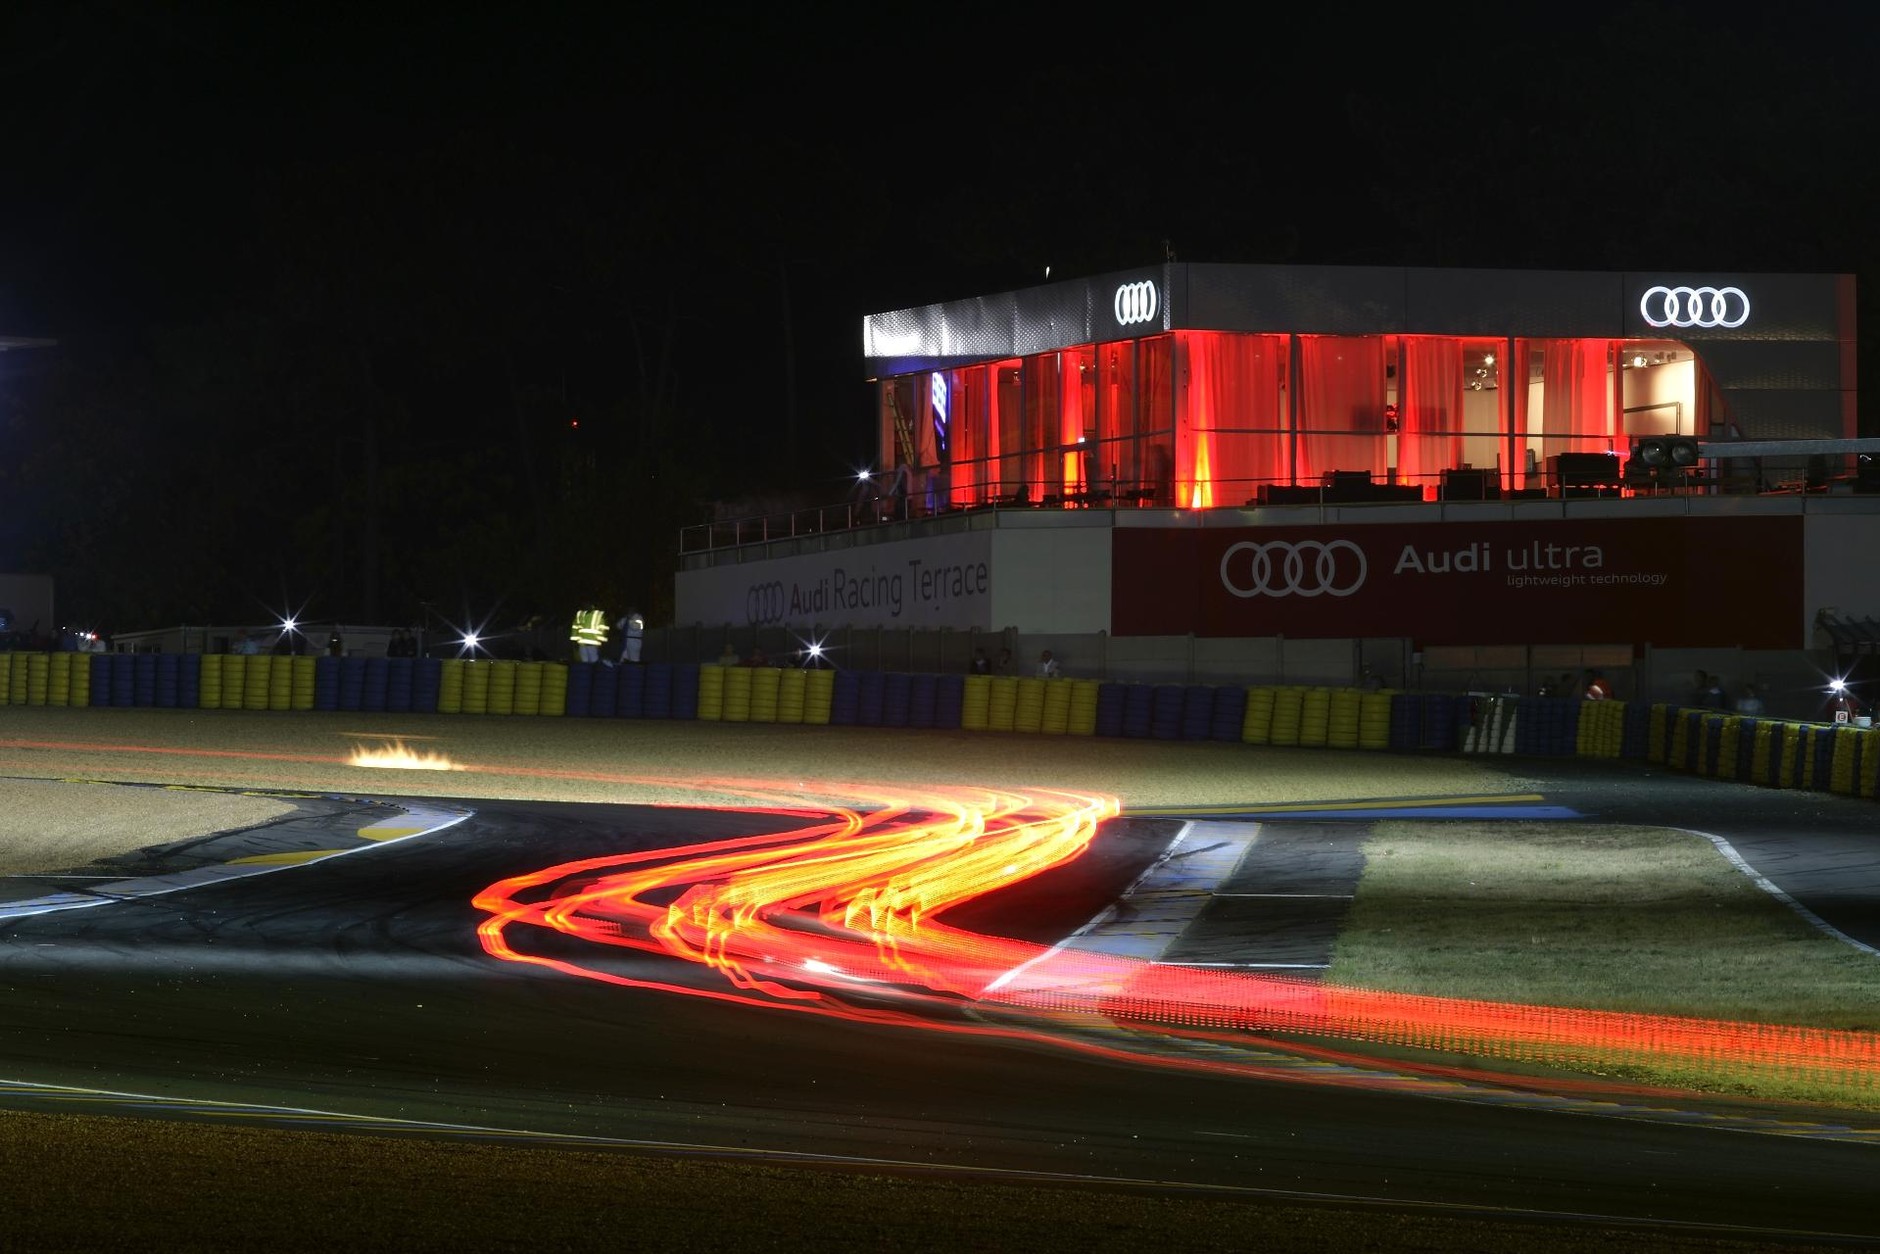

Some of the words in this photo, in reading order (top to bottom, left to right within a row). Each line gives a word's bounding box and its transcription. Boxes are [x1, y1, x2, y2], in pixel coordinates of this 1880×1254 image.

[1393, 542, 1491, 575] Audi
[1507, 540, 1603, 570] ultra
[789, 577, 829, 616] Audi
[833, 566, 903, 617] Racing
[908, 559, 988, 601] Terrace
[1506, 573, 1586, 588] lightweight
[1589, 572, 1669, 586] technology
